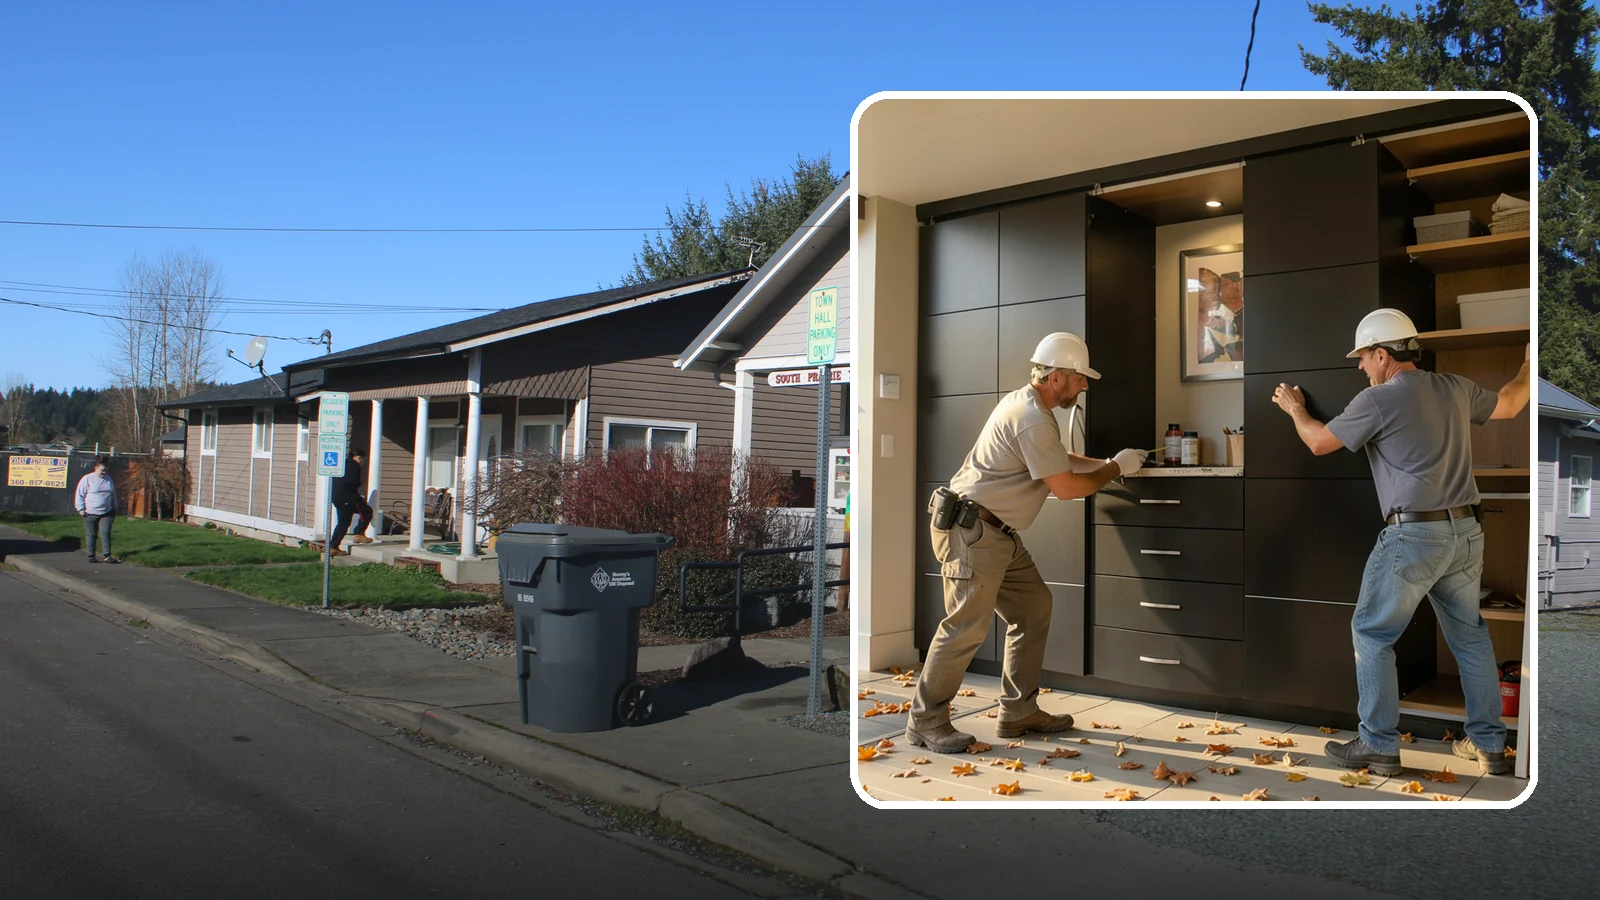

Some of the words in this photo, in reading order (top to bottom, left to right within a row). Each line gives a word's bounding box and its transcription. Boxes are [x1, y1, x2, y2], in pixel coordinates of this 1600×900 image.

[815, 295, 833, 307] TOWN
[815, 311, 831, 324] HALL
[810, 327, 835, 340] PARKING
[814, 344, 831, 357] ONLY
[775, 374, 801, 384] SOUTH
[808, 371, 842, 382] PRIE
